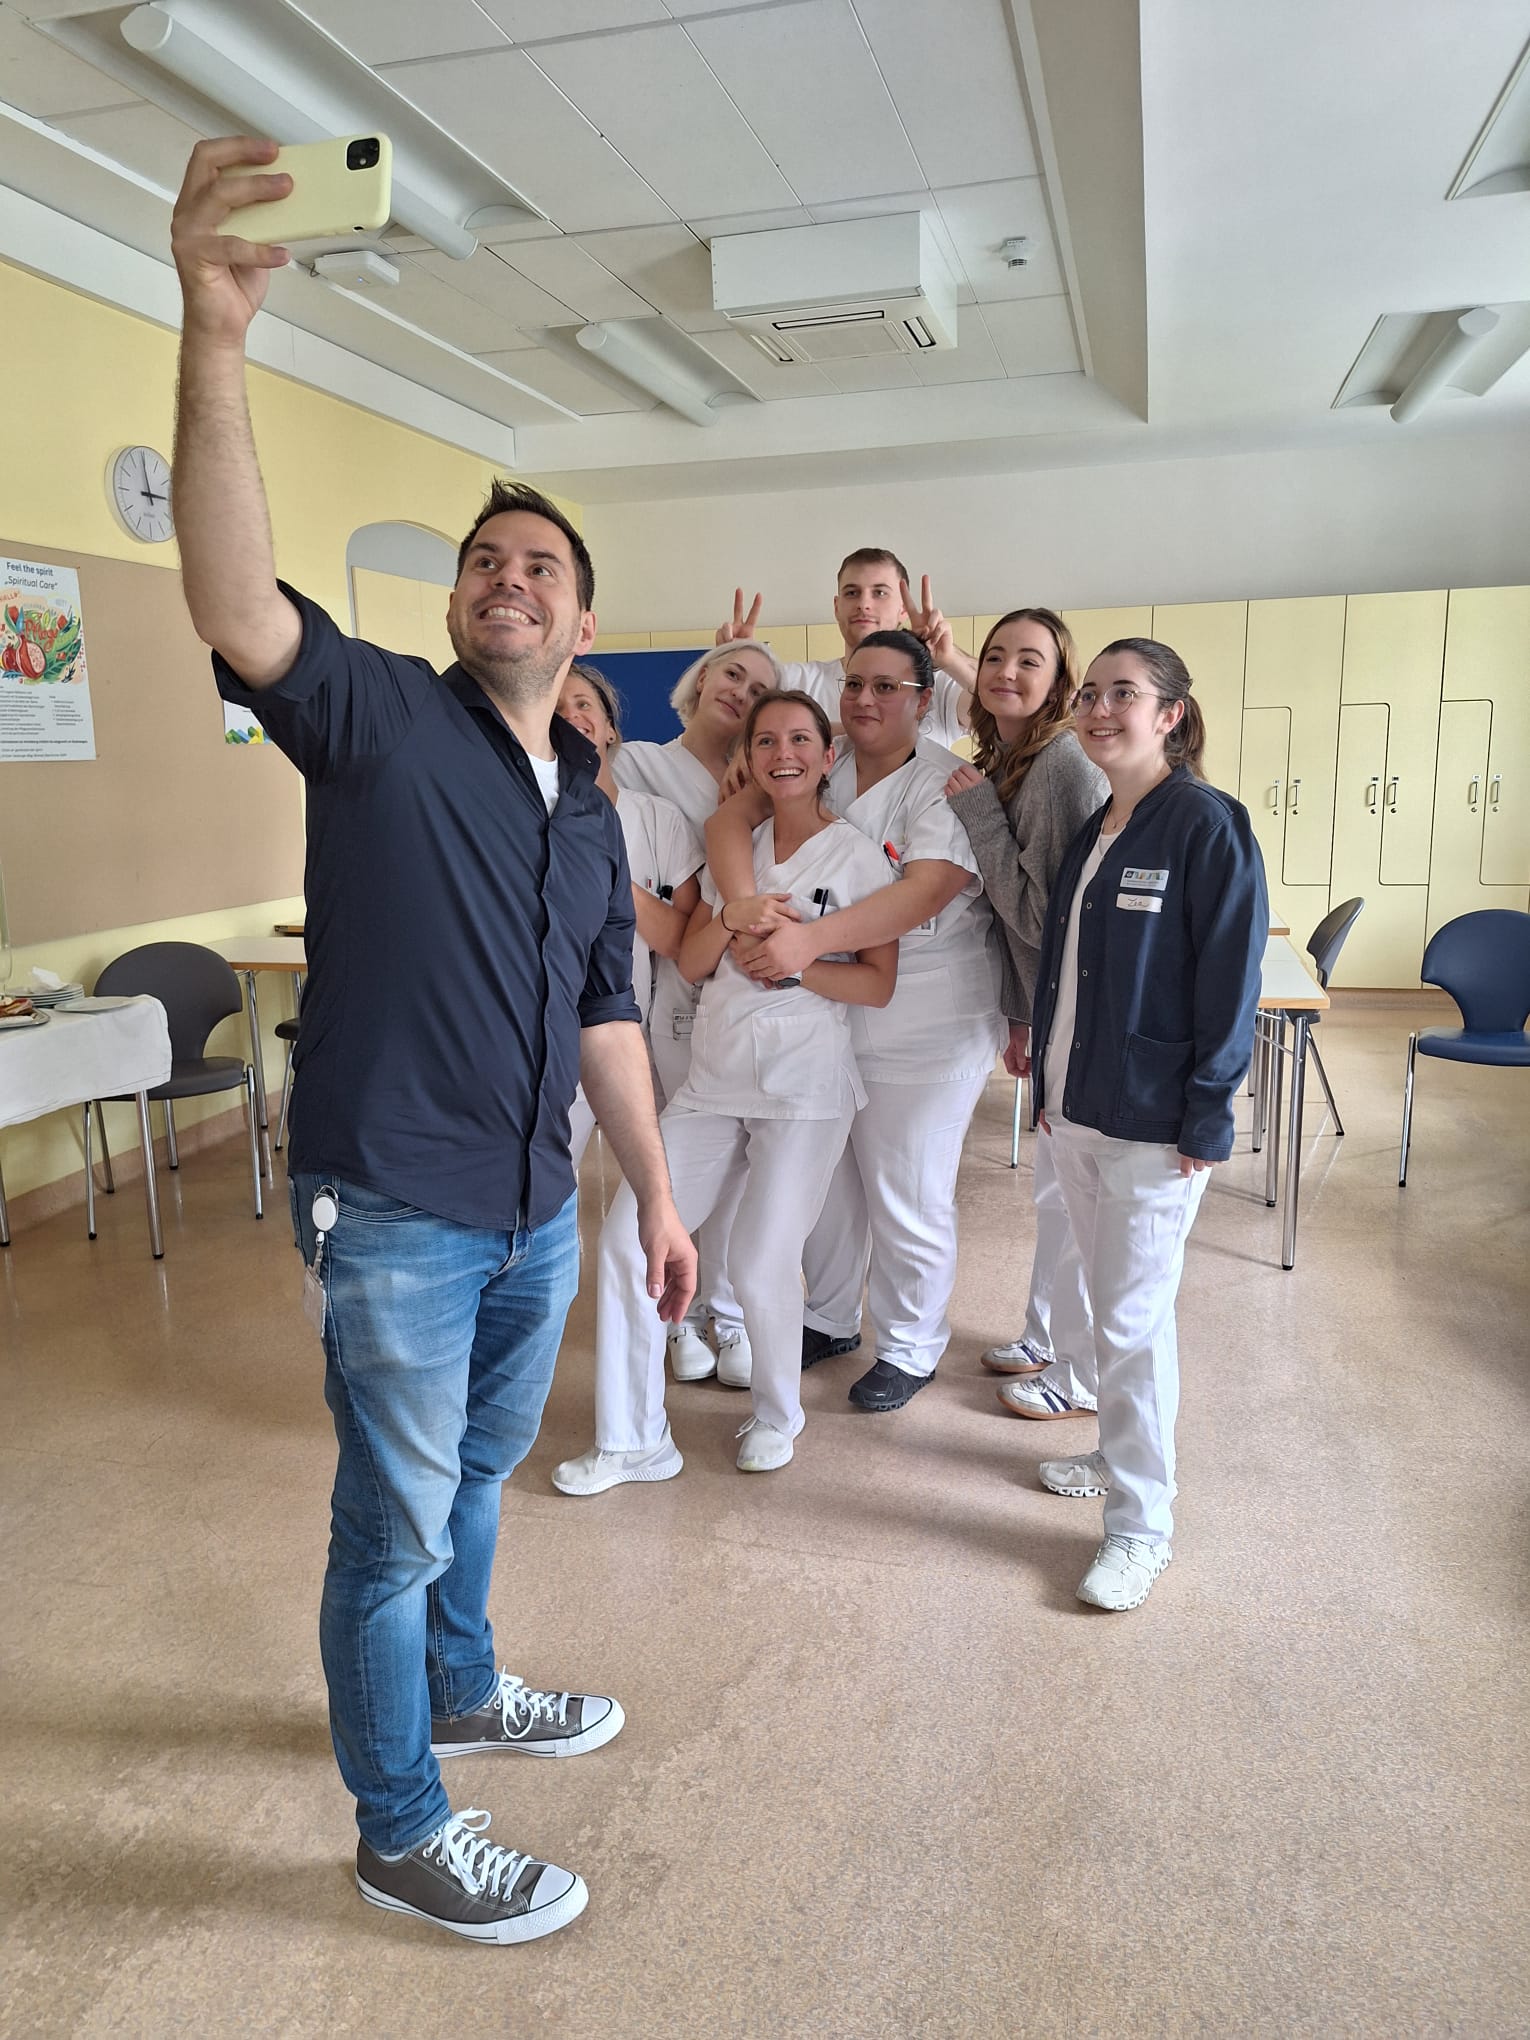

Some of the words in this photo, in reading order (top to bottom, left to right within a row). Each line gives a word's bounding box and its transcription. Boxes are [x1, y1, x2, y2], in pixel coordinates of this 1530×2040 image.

[6, 561, 22, 572] Feel
[23, 564, 35, 574] the
[36, 566, 54, 577] spirit
